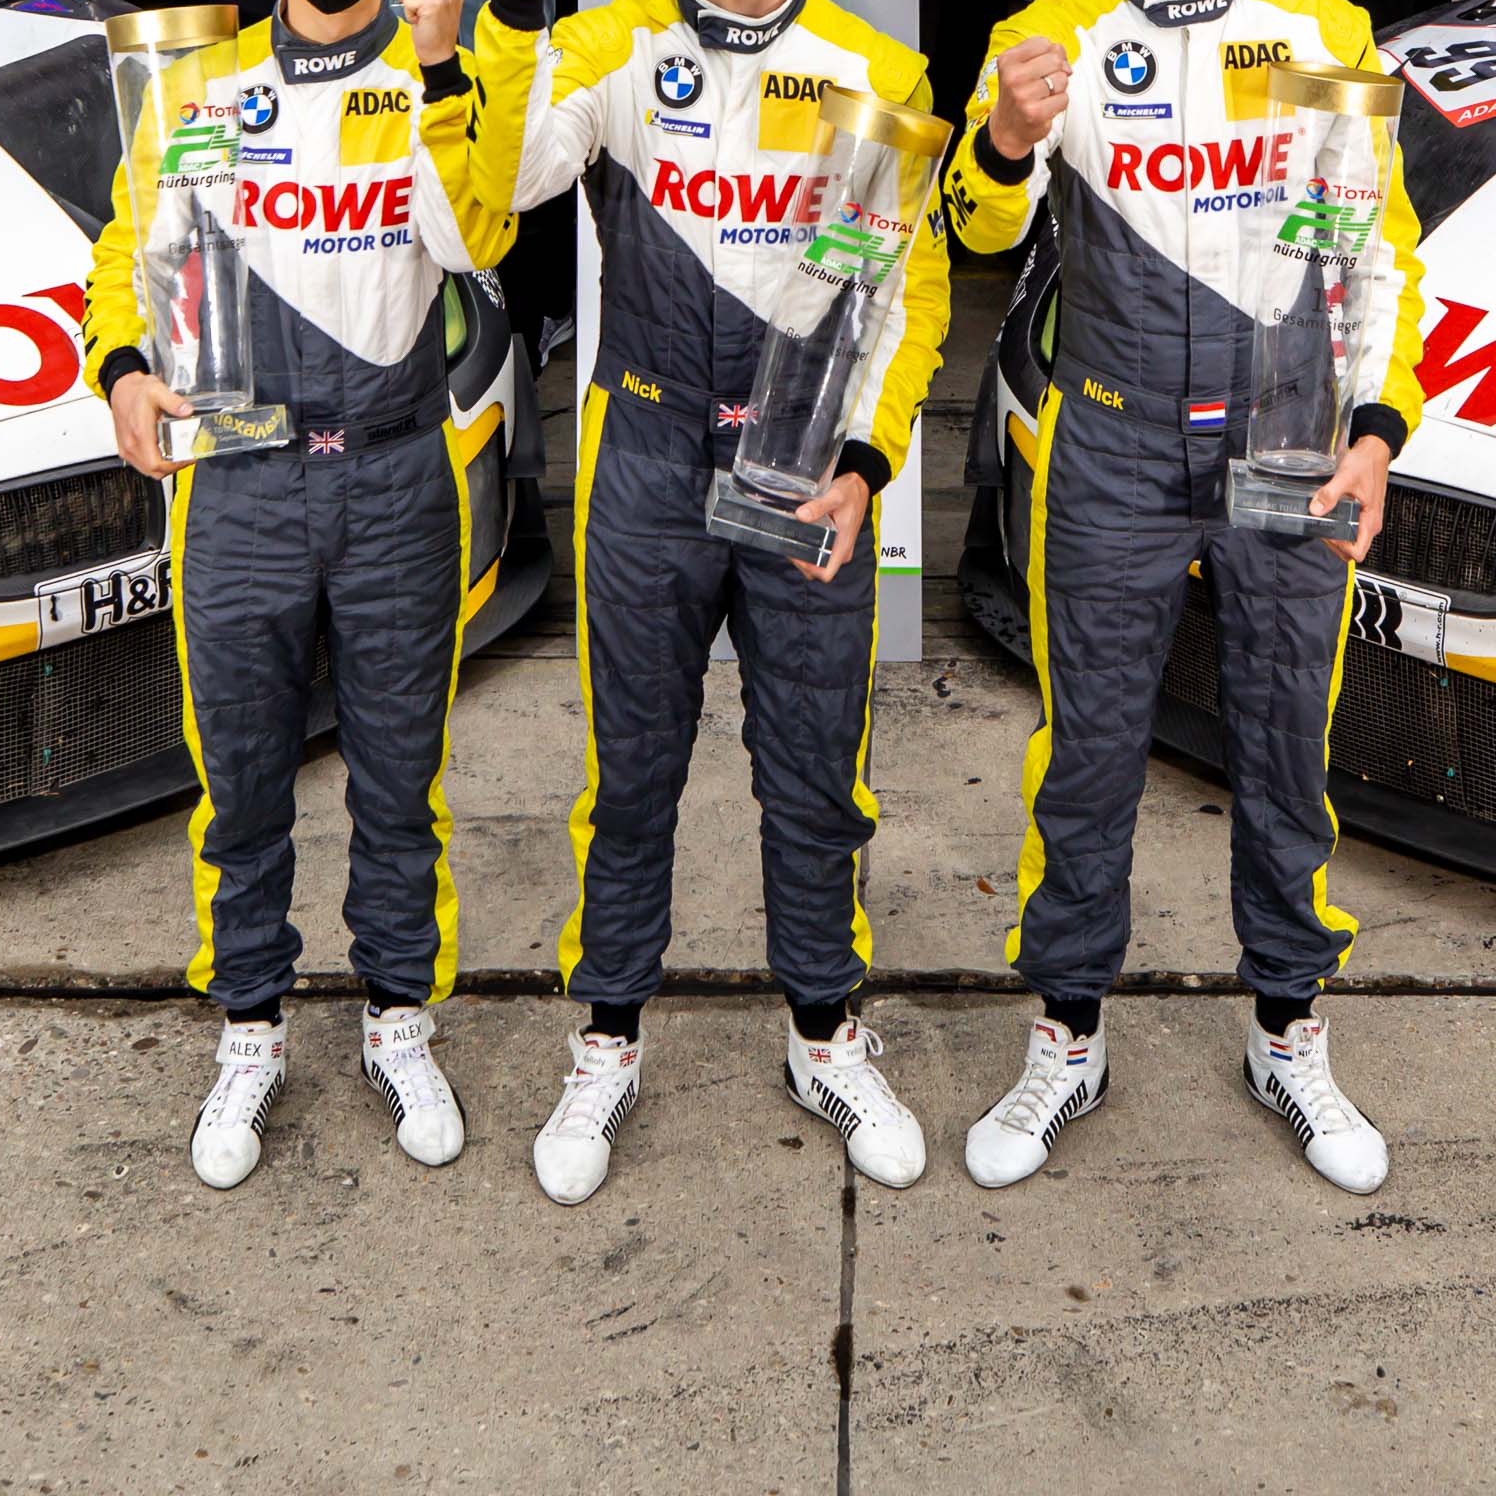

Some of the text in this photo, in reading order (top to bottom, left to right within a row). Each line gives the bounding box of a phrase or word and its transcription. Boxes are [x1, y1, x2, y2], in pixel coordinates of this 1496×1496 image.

[294, 51, 357, 76] ROWE
[1224, 41, 1291, 71] ADAC
[345, 90, 411, 117] ADAC
[1116, 106, 1167, 117] MICHELIN
[1106, 132, 1293, 193] ROWE
[650, 158, 831, 223] ROWE
[1193, 192, 1261, 214] MOTOR
[1333, 184, 1384, 201] TOTAL
[233, 176, 413, 233] ROWE
[303, 230, 413, 255] MOTOR OIL
[720, 226, 791, 246] MOTOR
[1273, 243, 1358, 270] nürburgring
[797, 261, 878, 299] nürburgring
[622, 370, 663, 404] Nick
[1082, 377, 1124, 411] Nick
[392, 1023, 423, 1044] ALEX
[229, 1040, 262, 1057] ALEX
